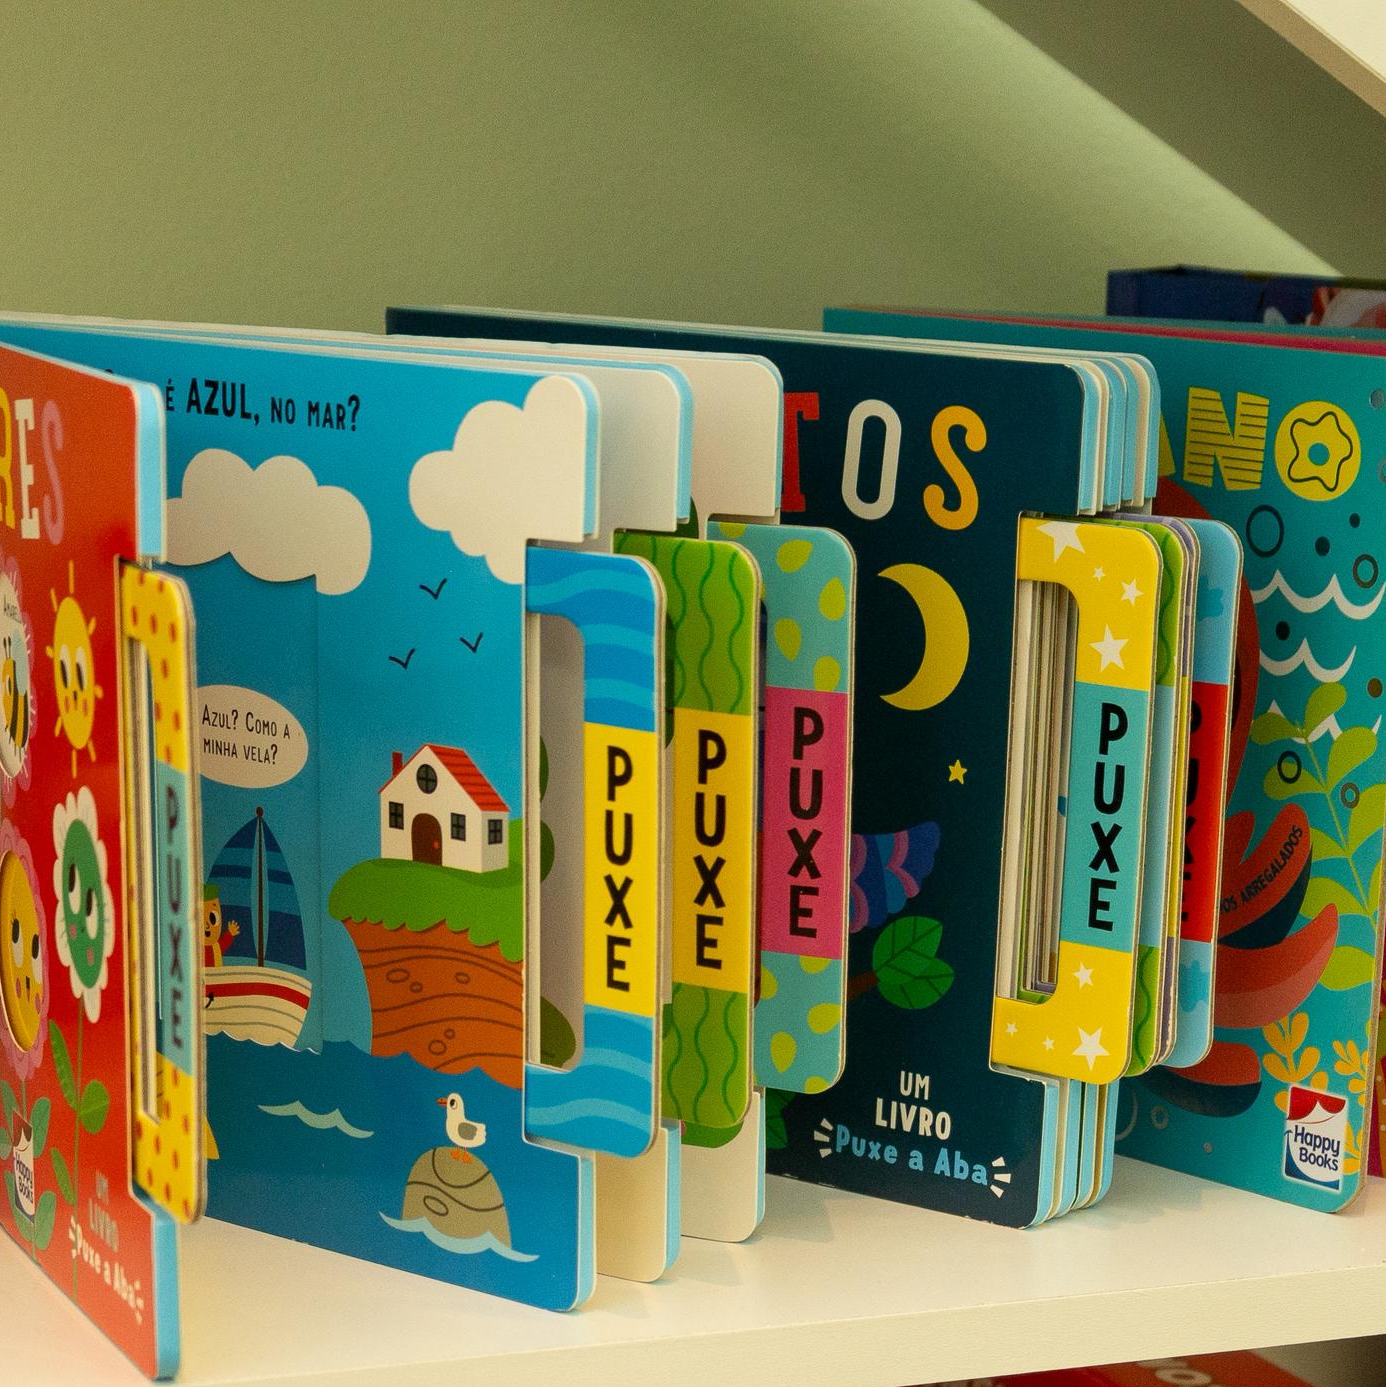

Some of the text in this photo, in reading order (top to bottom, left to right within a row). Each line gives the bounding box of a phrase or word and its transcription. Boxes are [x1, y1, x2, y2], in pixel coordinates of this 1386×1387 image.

[186, 378, 261, 426] AZUL,
[270, 397, 296, 424] NO
[307, 394, 360, 431] MAR?
[202, 704, 291, 740] AZUL? COMO A
[203, 738, 278, 766] MINHA VELA?
[786, 706, 826, 941] PUXE
[1087, 703, 1131, 933] PUXE
[602, 746, 636, 994] PUXE
[693, 729, 728, 972] PUXE
[1240, 824, 1303, 906] ARREGALADOS
[166, 785, 184, 1050] PUXE
[899, 1070, 930, 1100] UM
[875, 1097, 952, 1141] LIVRO
[1293, 1124, 1341, 1158] Happy
[835, 1124, 988, 1186] Puxe a Aba
[1298, 1146, 1340, 1172] Books
